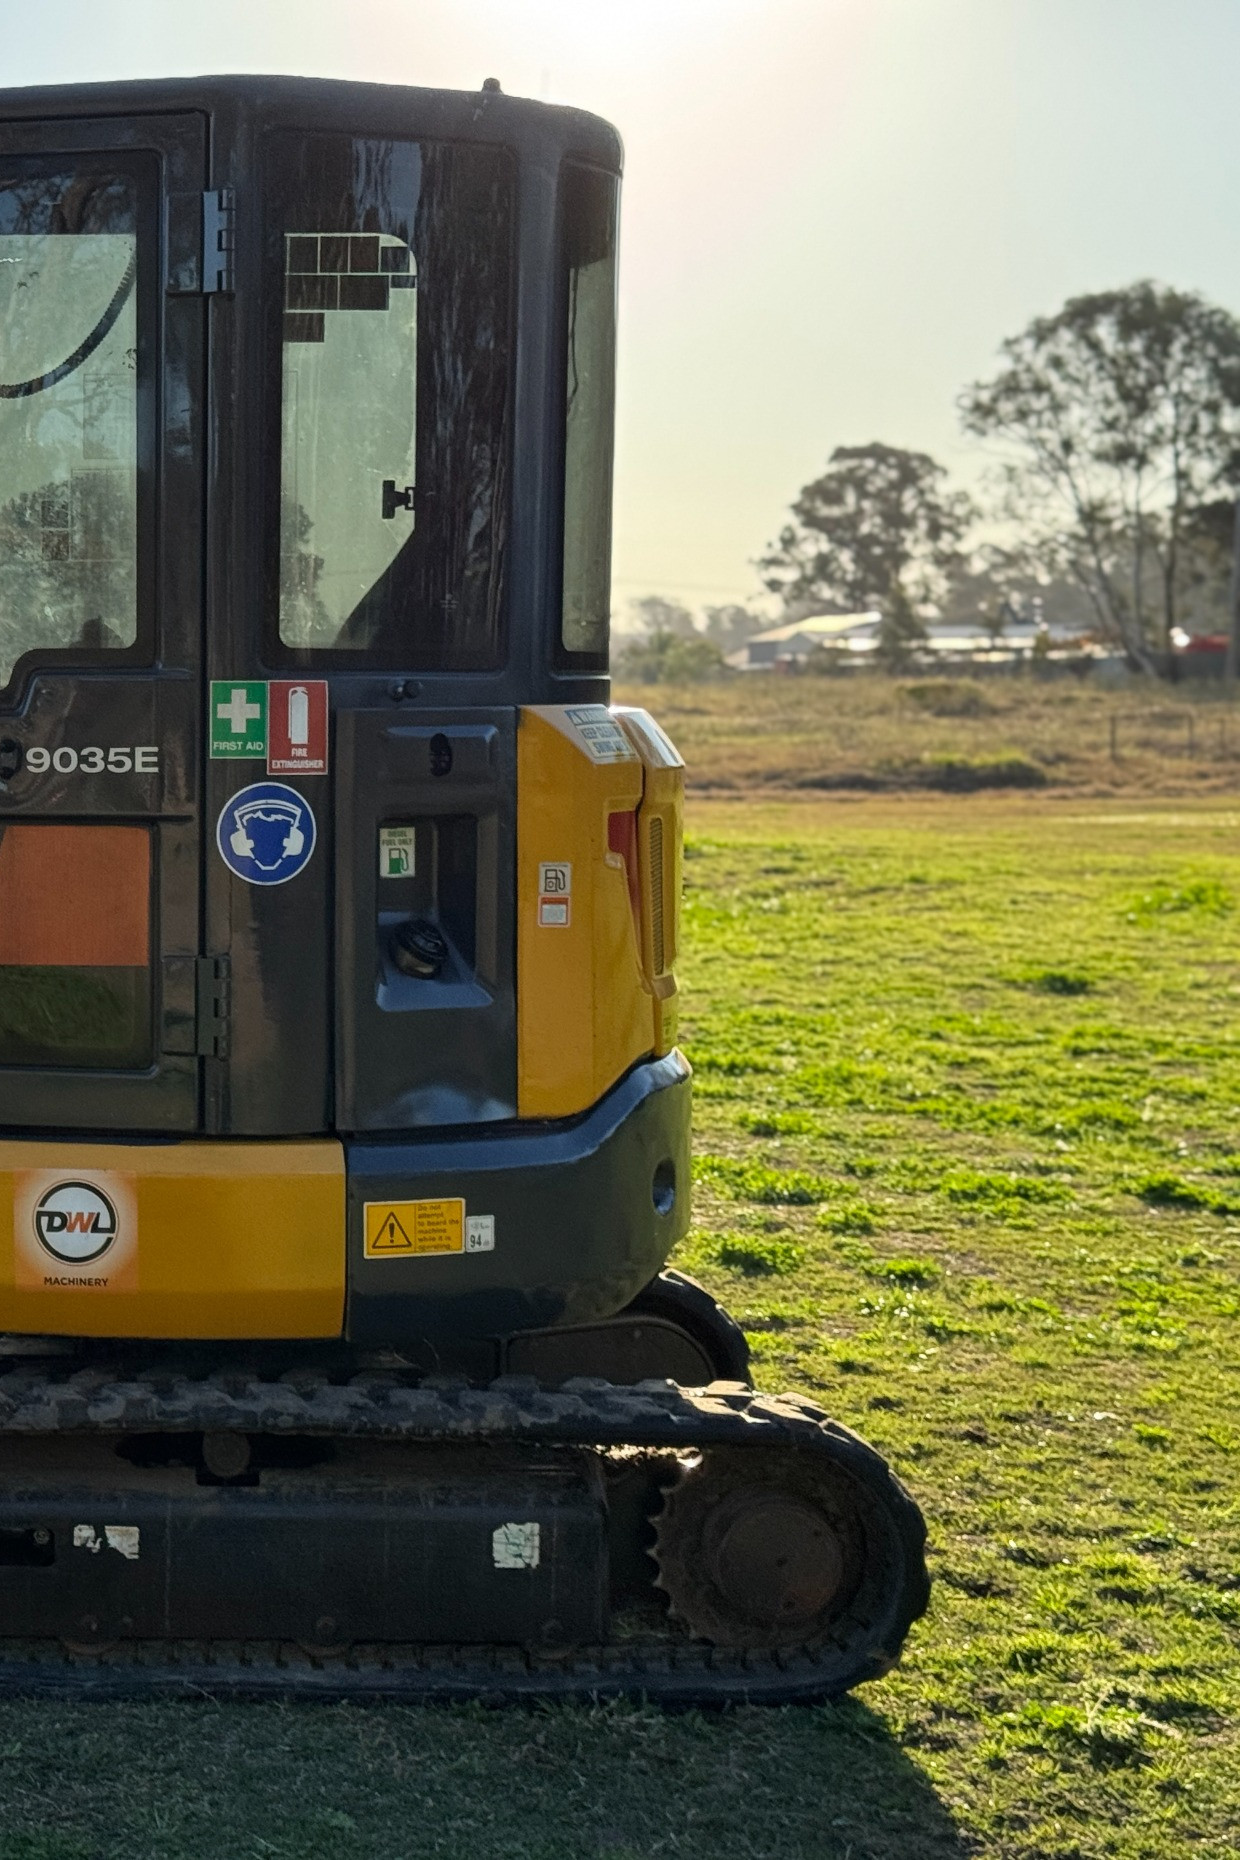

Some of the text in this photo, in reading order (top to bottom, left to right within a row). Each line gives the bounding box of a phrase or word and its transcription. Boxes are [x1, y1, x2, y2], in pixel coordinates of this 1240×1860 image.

[213, 741, 264, 751] FIRST AID
[291, 748, 308, 757] FIRE
[26, 746, 159, 773] 9035E
[272, 760, 324, 769] EXTINGUISHER
[398, 838, 413, 846] ONLY
[37, 1210, 114, 1234] DWL
[470, 1234, 482, 1249] 94
[44, 1276, 109, 1287] MACHINERY
